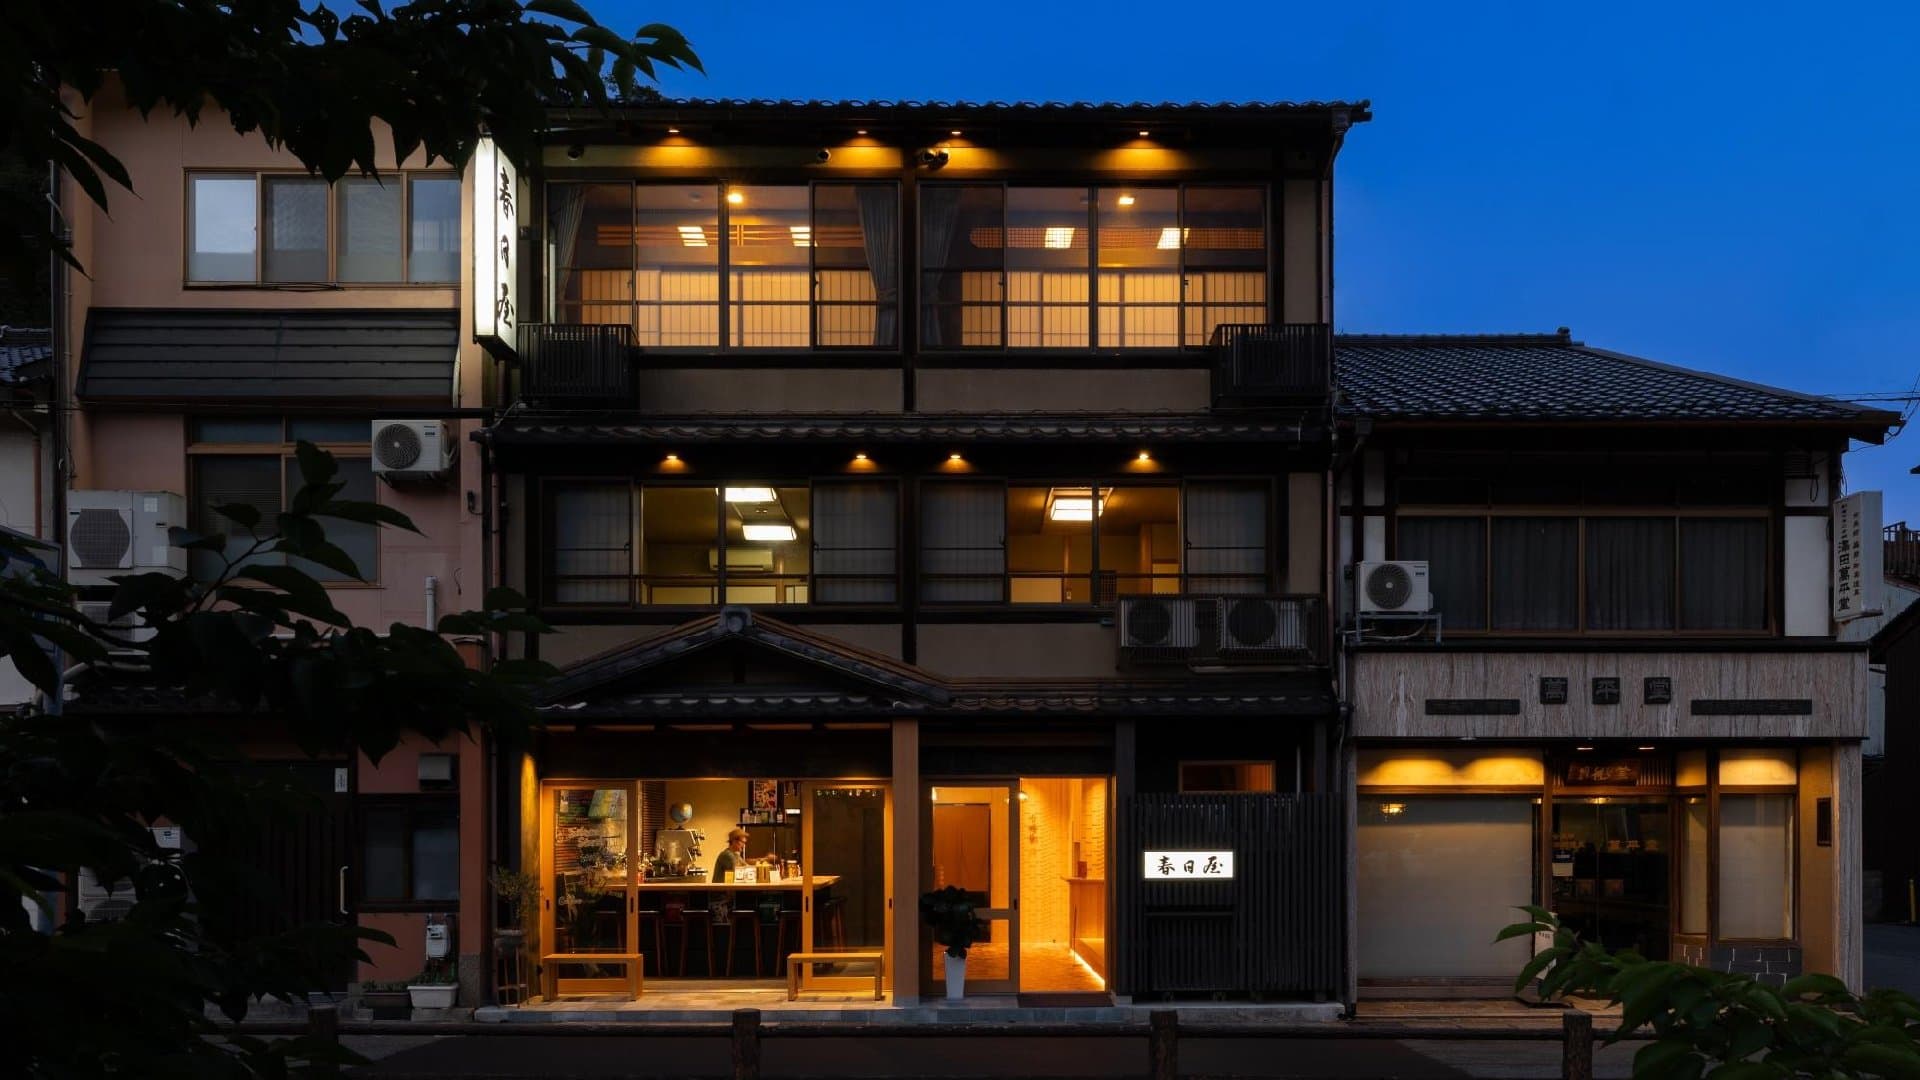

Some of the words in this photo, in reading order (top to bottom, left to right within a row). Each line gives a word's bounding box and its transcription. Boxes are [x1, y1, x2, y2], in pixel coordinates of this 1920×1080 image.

[498, 166, 514, 329] 春日屋
[1157, 855, 1224, 876] 春日屋
